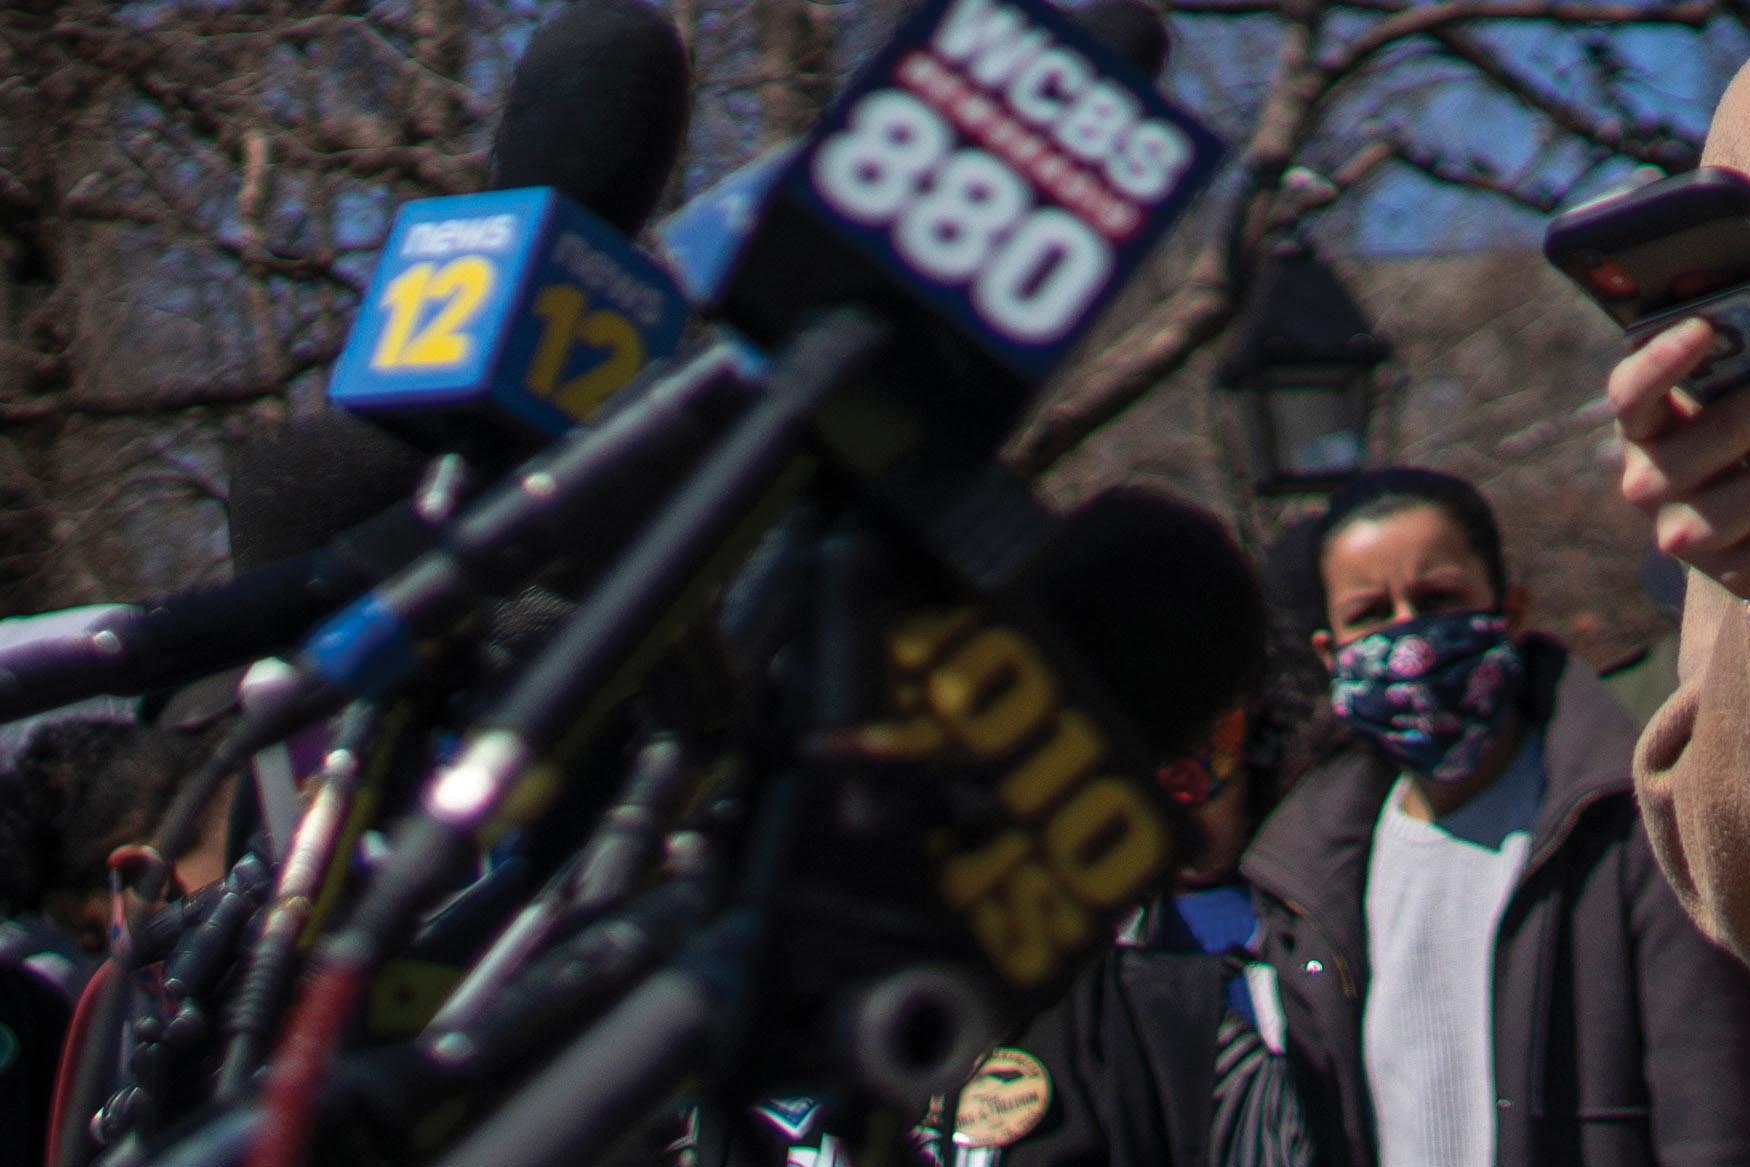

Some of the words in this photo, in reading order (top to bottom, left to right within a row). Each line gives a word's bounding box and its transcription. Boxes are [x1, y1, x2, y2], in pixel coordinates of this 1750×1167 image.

[402, 214, 517, 255] news
[812, 88, 1111, 345] 880
[371, 256, 493, 371] 12
[525, 283, 646, 420] 12
